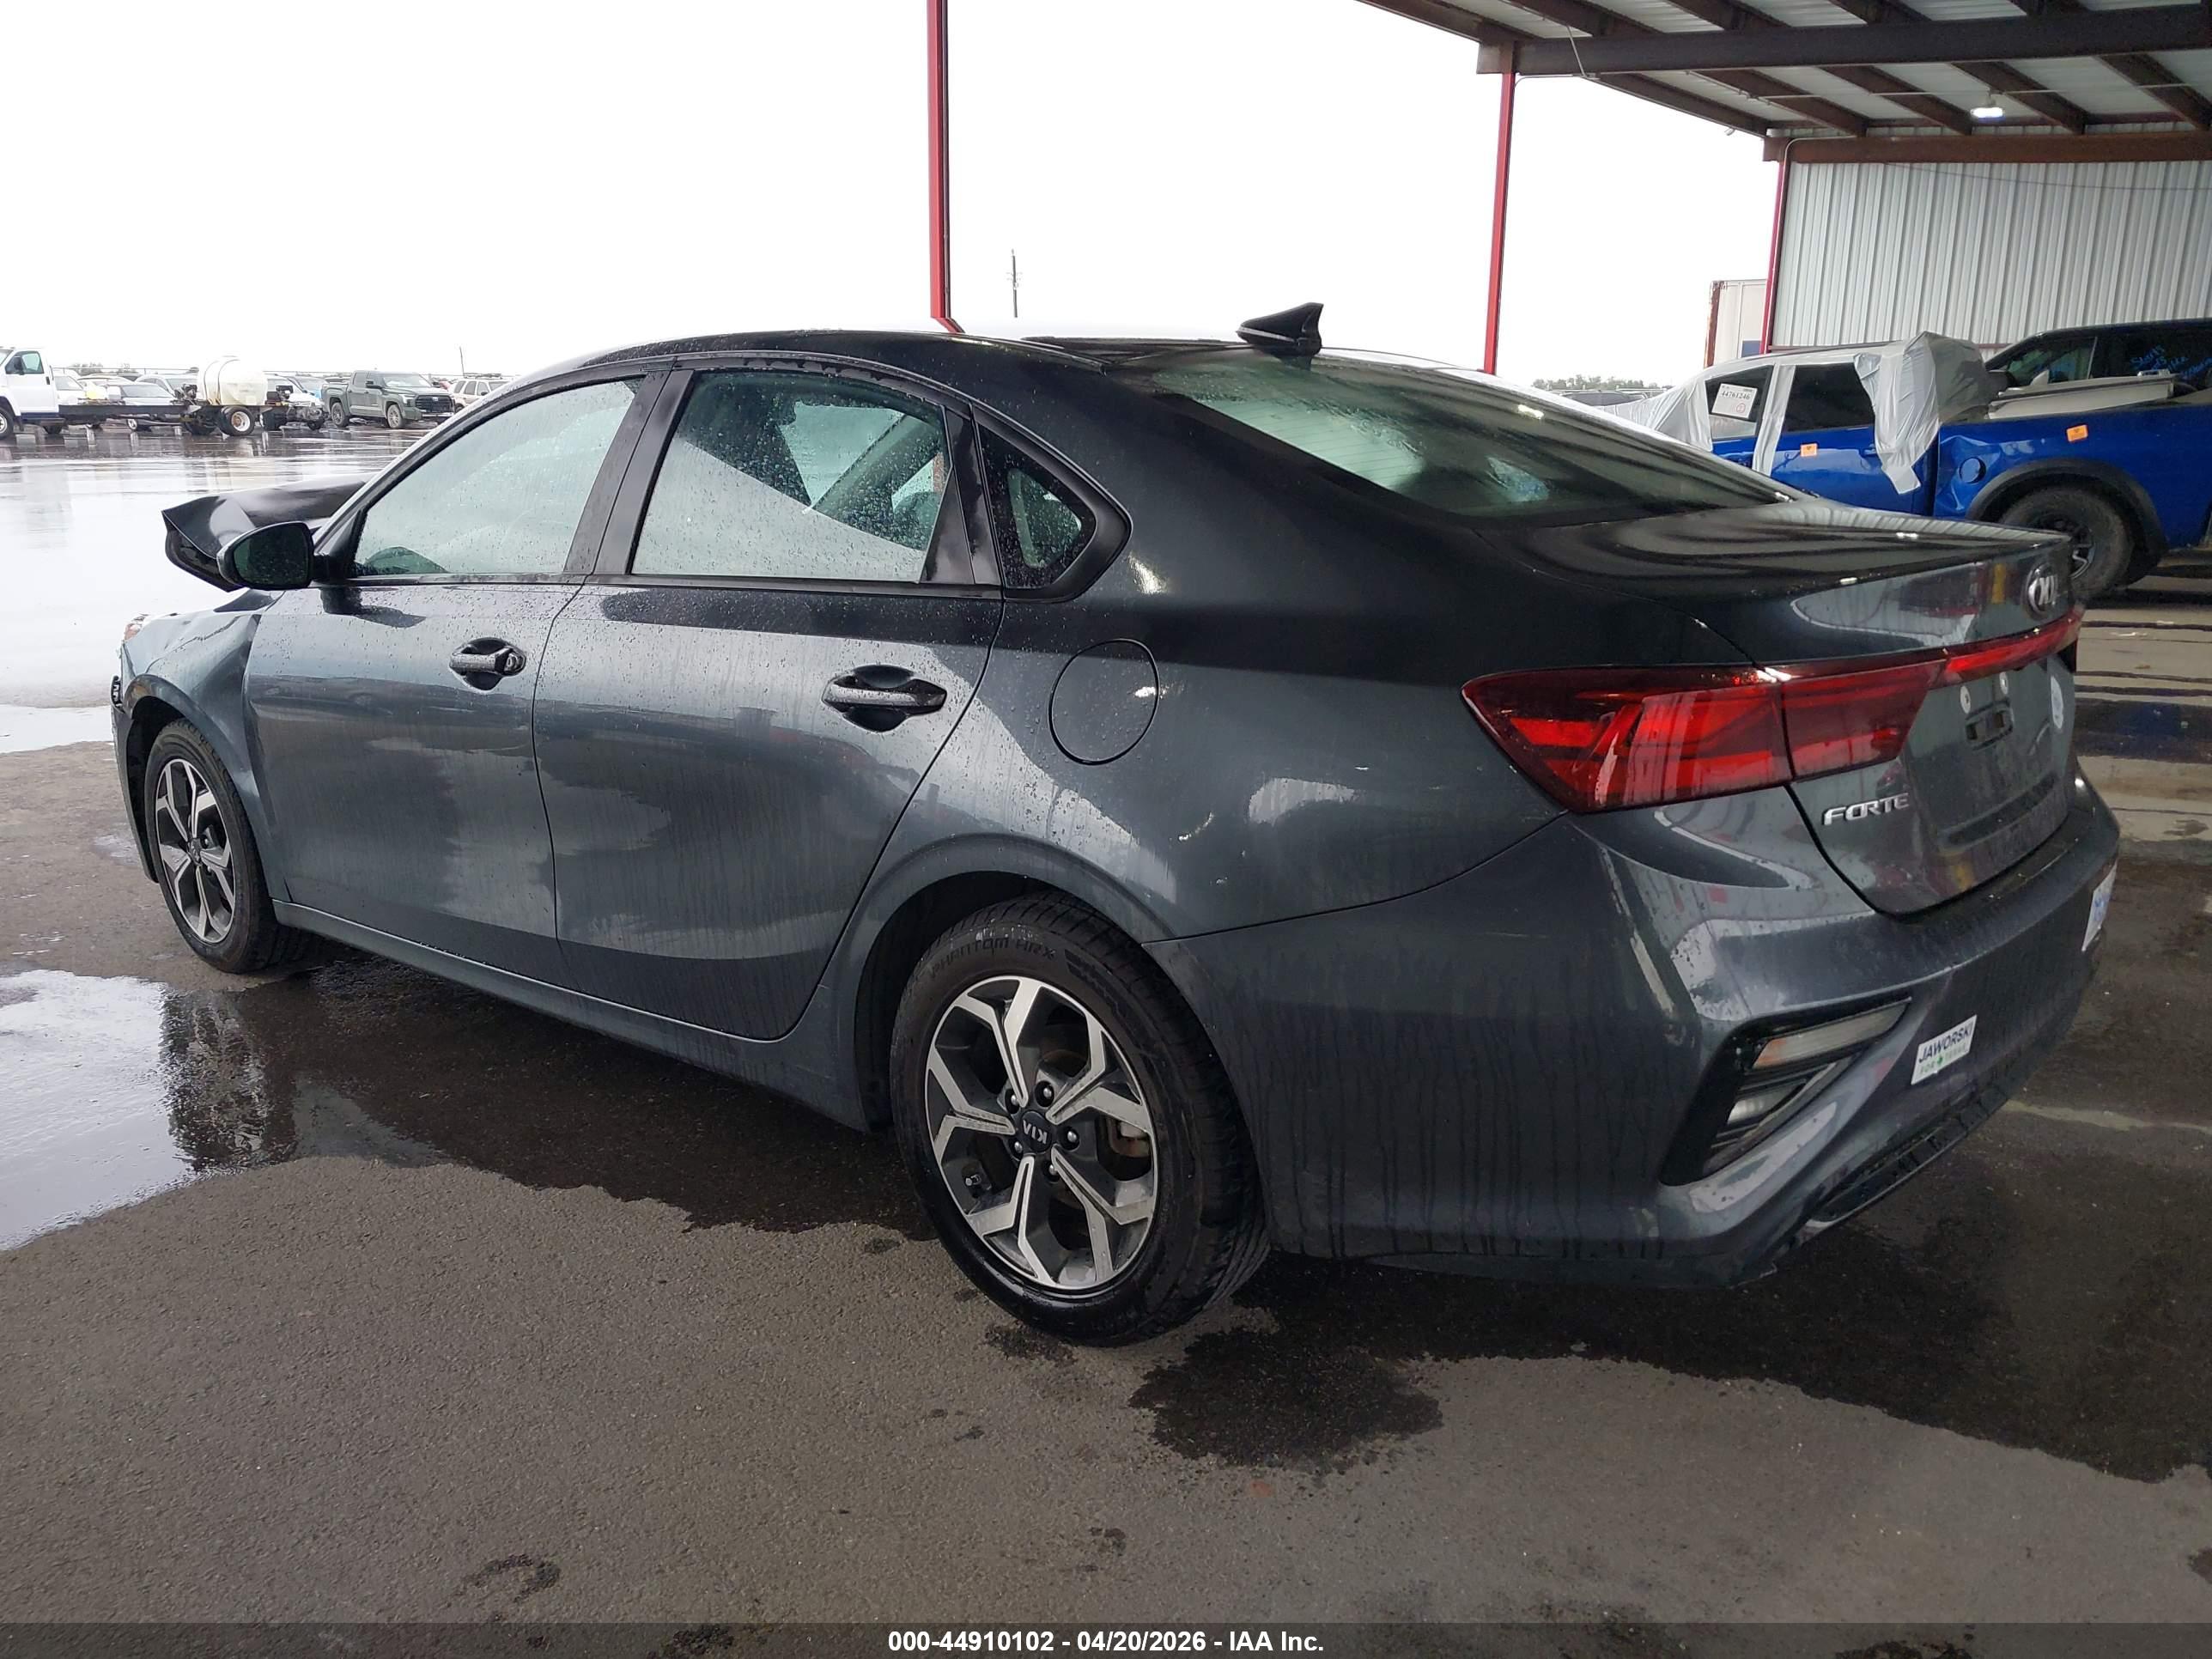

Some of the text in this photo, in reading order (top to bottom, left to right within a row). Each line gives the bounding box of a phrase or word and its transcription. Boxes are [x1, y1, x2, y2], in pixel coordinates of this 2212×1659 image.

[1824, 792, 1909, 825] FORTE
[1918, 1021, 1973, 1064] JAWORSKI
[1023, 1119, 1048, 1145] KIA
